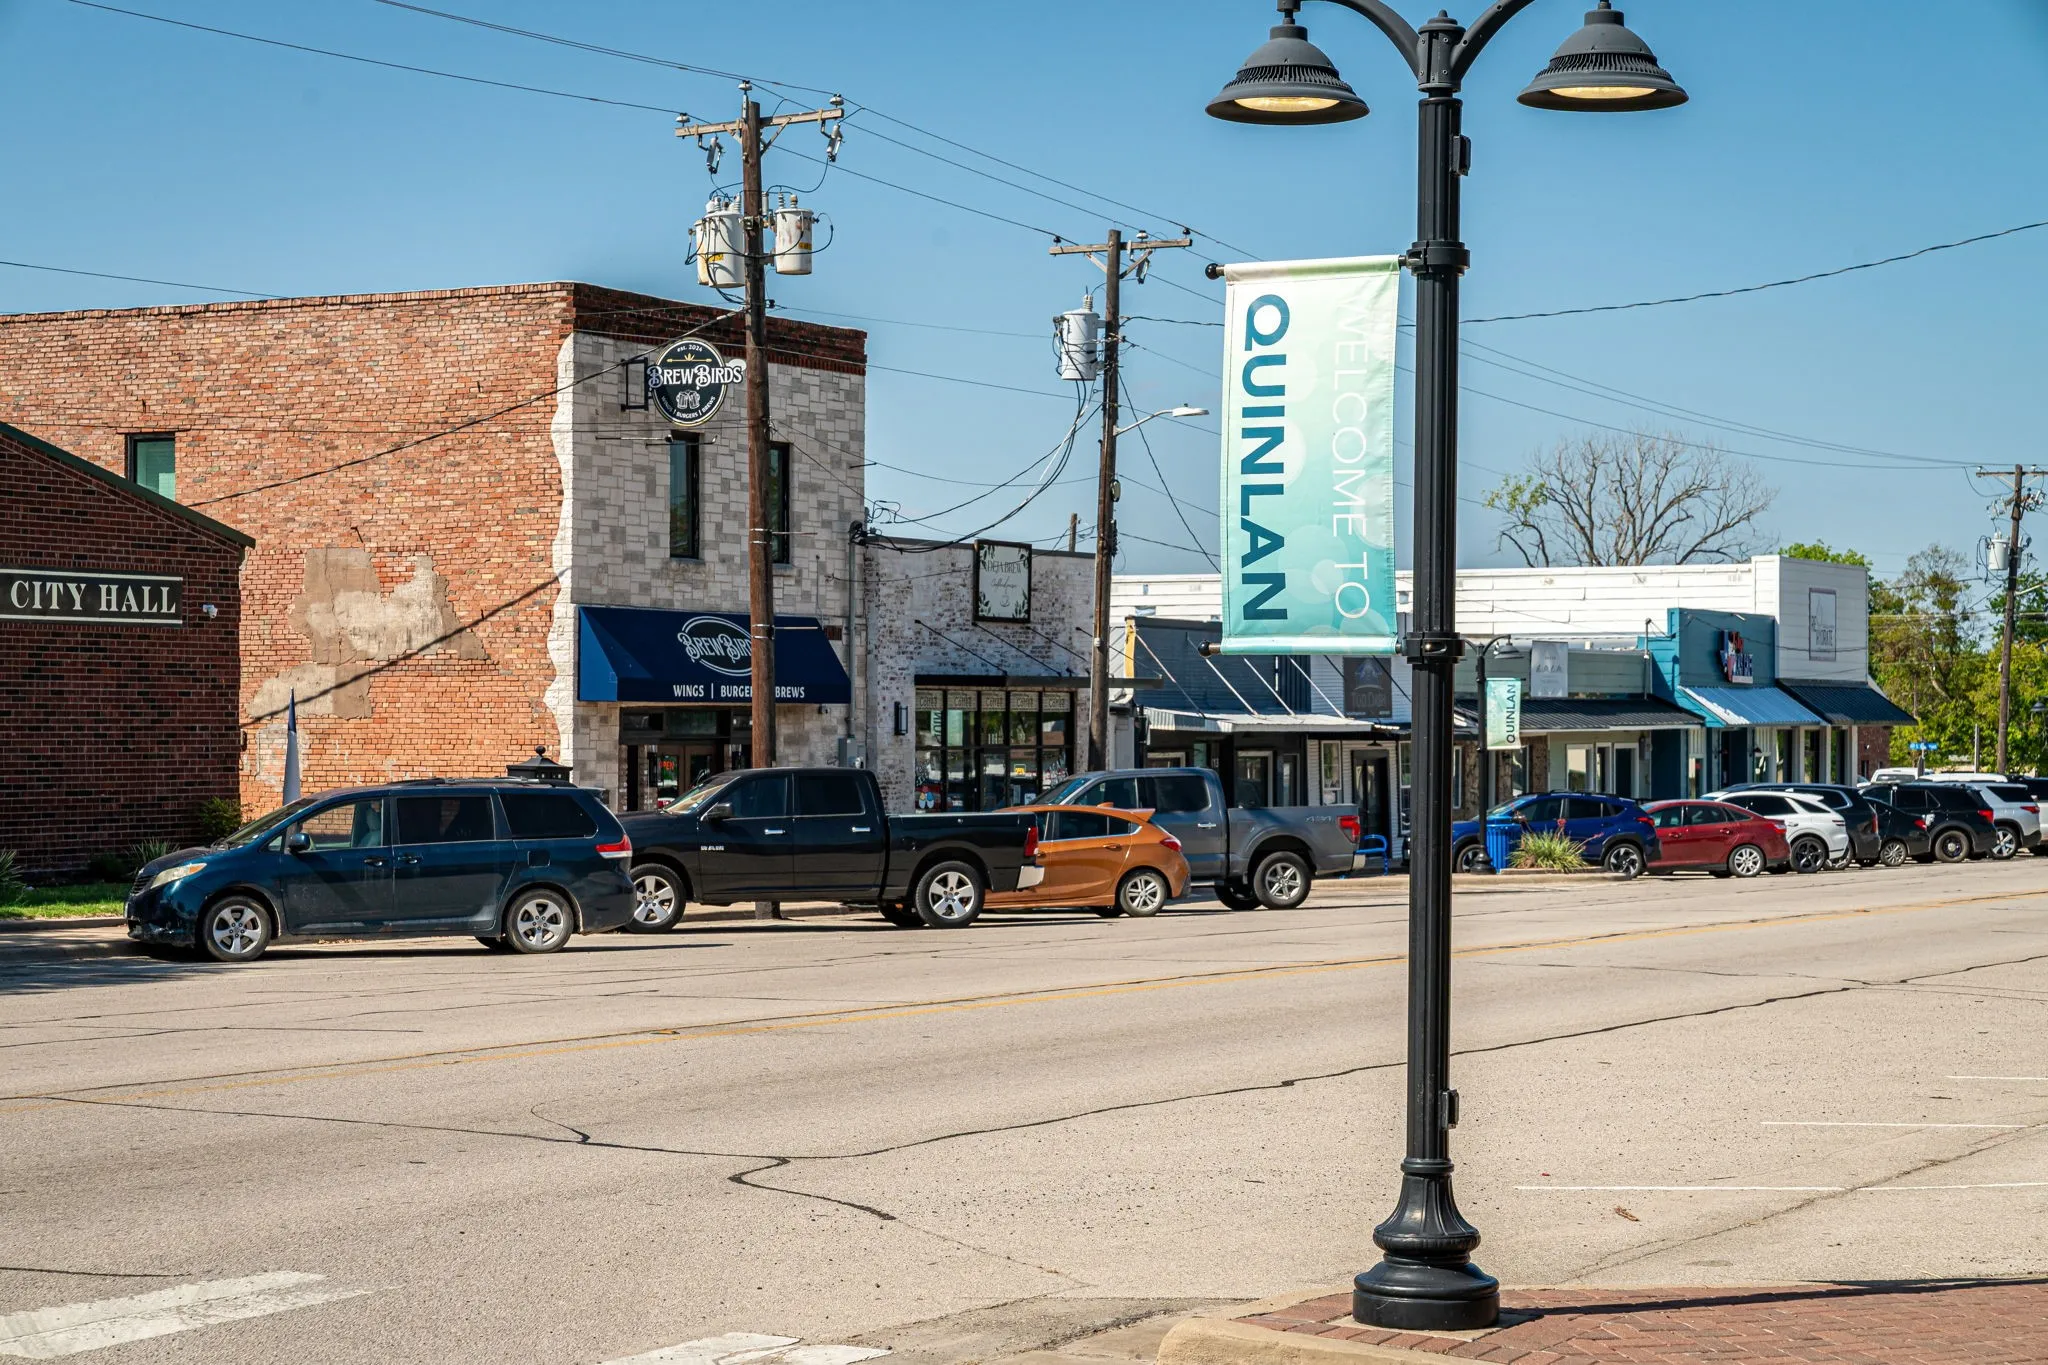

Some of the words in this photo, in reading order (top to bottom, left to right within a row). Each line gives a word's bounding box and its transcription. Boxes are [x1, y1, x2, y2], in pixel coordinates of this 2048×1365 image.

[689, 344, 704, 353] 2024
[1332, 293, 1369, 537] WELCOME
[1239, 293, 1291, 621] QUINLAN
[10, 579, 88, 611] CITY
[98, 584, 177, 614] HALL
[1334, 551, 1371, 620] TO
[673, 685, 704, 698] WINGS
[720, 685, 753, 698] BURGE
[775, 686, 805, 699] BREWS
[1506, 684, 1516, 744] QUINLAN
